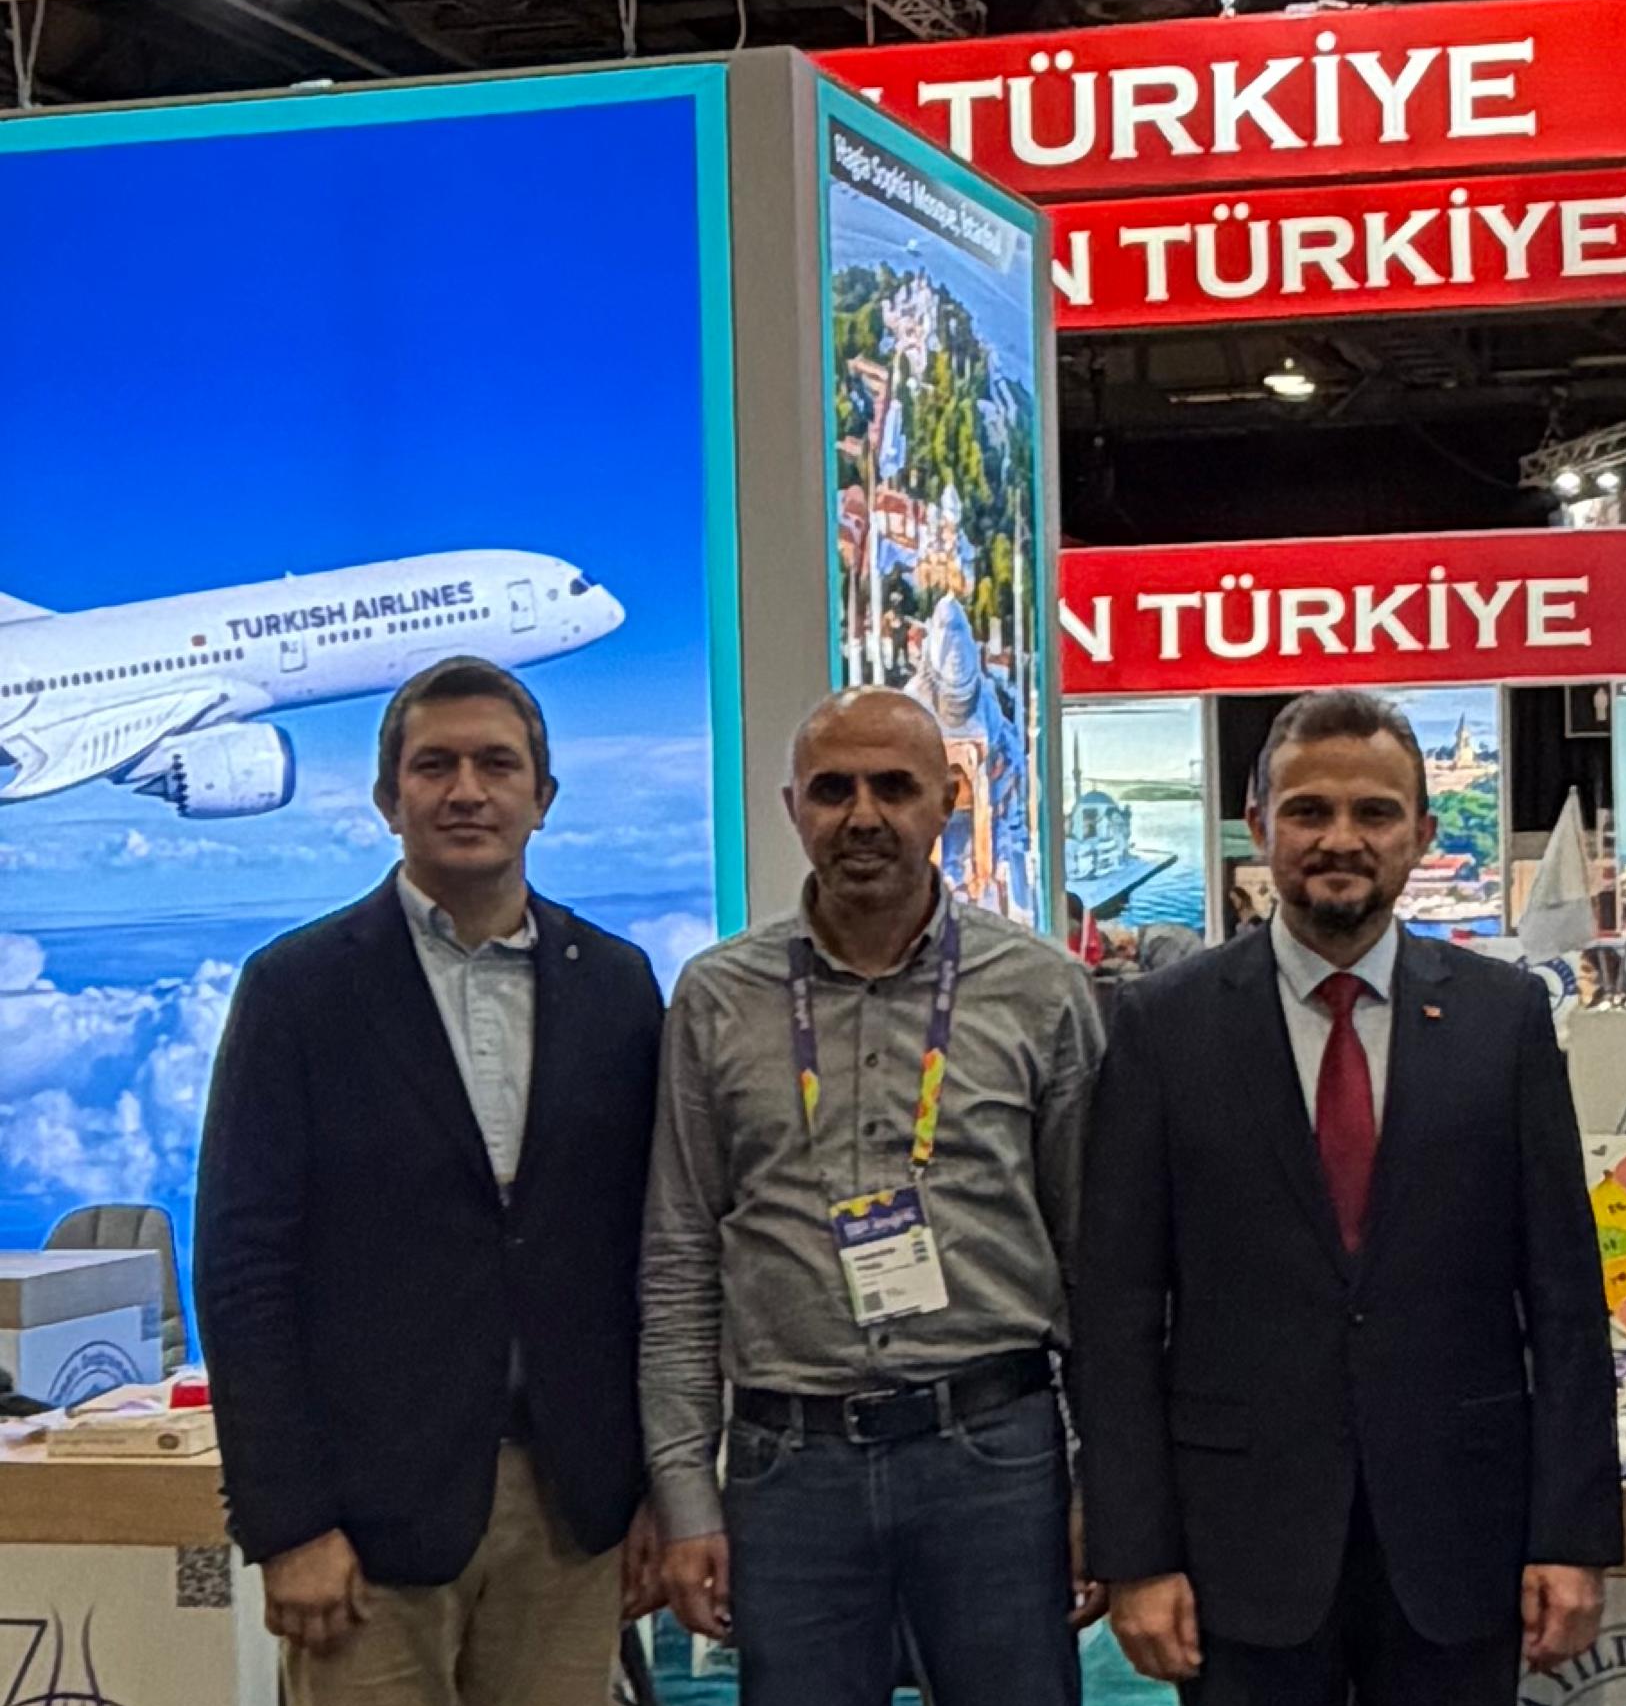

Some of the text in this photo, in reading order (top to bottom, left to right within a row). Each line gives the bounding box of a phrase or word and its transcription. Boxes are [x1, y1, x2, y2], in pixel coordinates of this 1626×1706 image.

[917, 30, 1537, 166] TÜRKİYE
[1051, 229, 1093, 306] N
[225, 580, 475, 642] TURKISH AIRLINES
[1058, 565, 1593, 662] N TÜRKİYE
